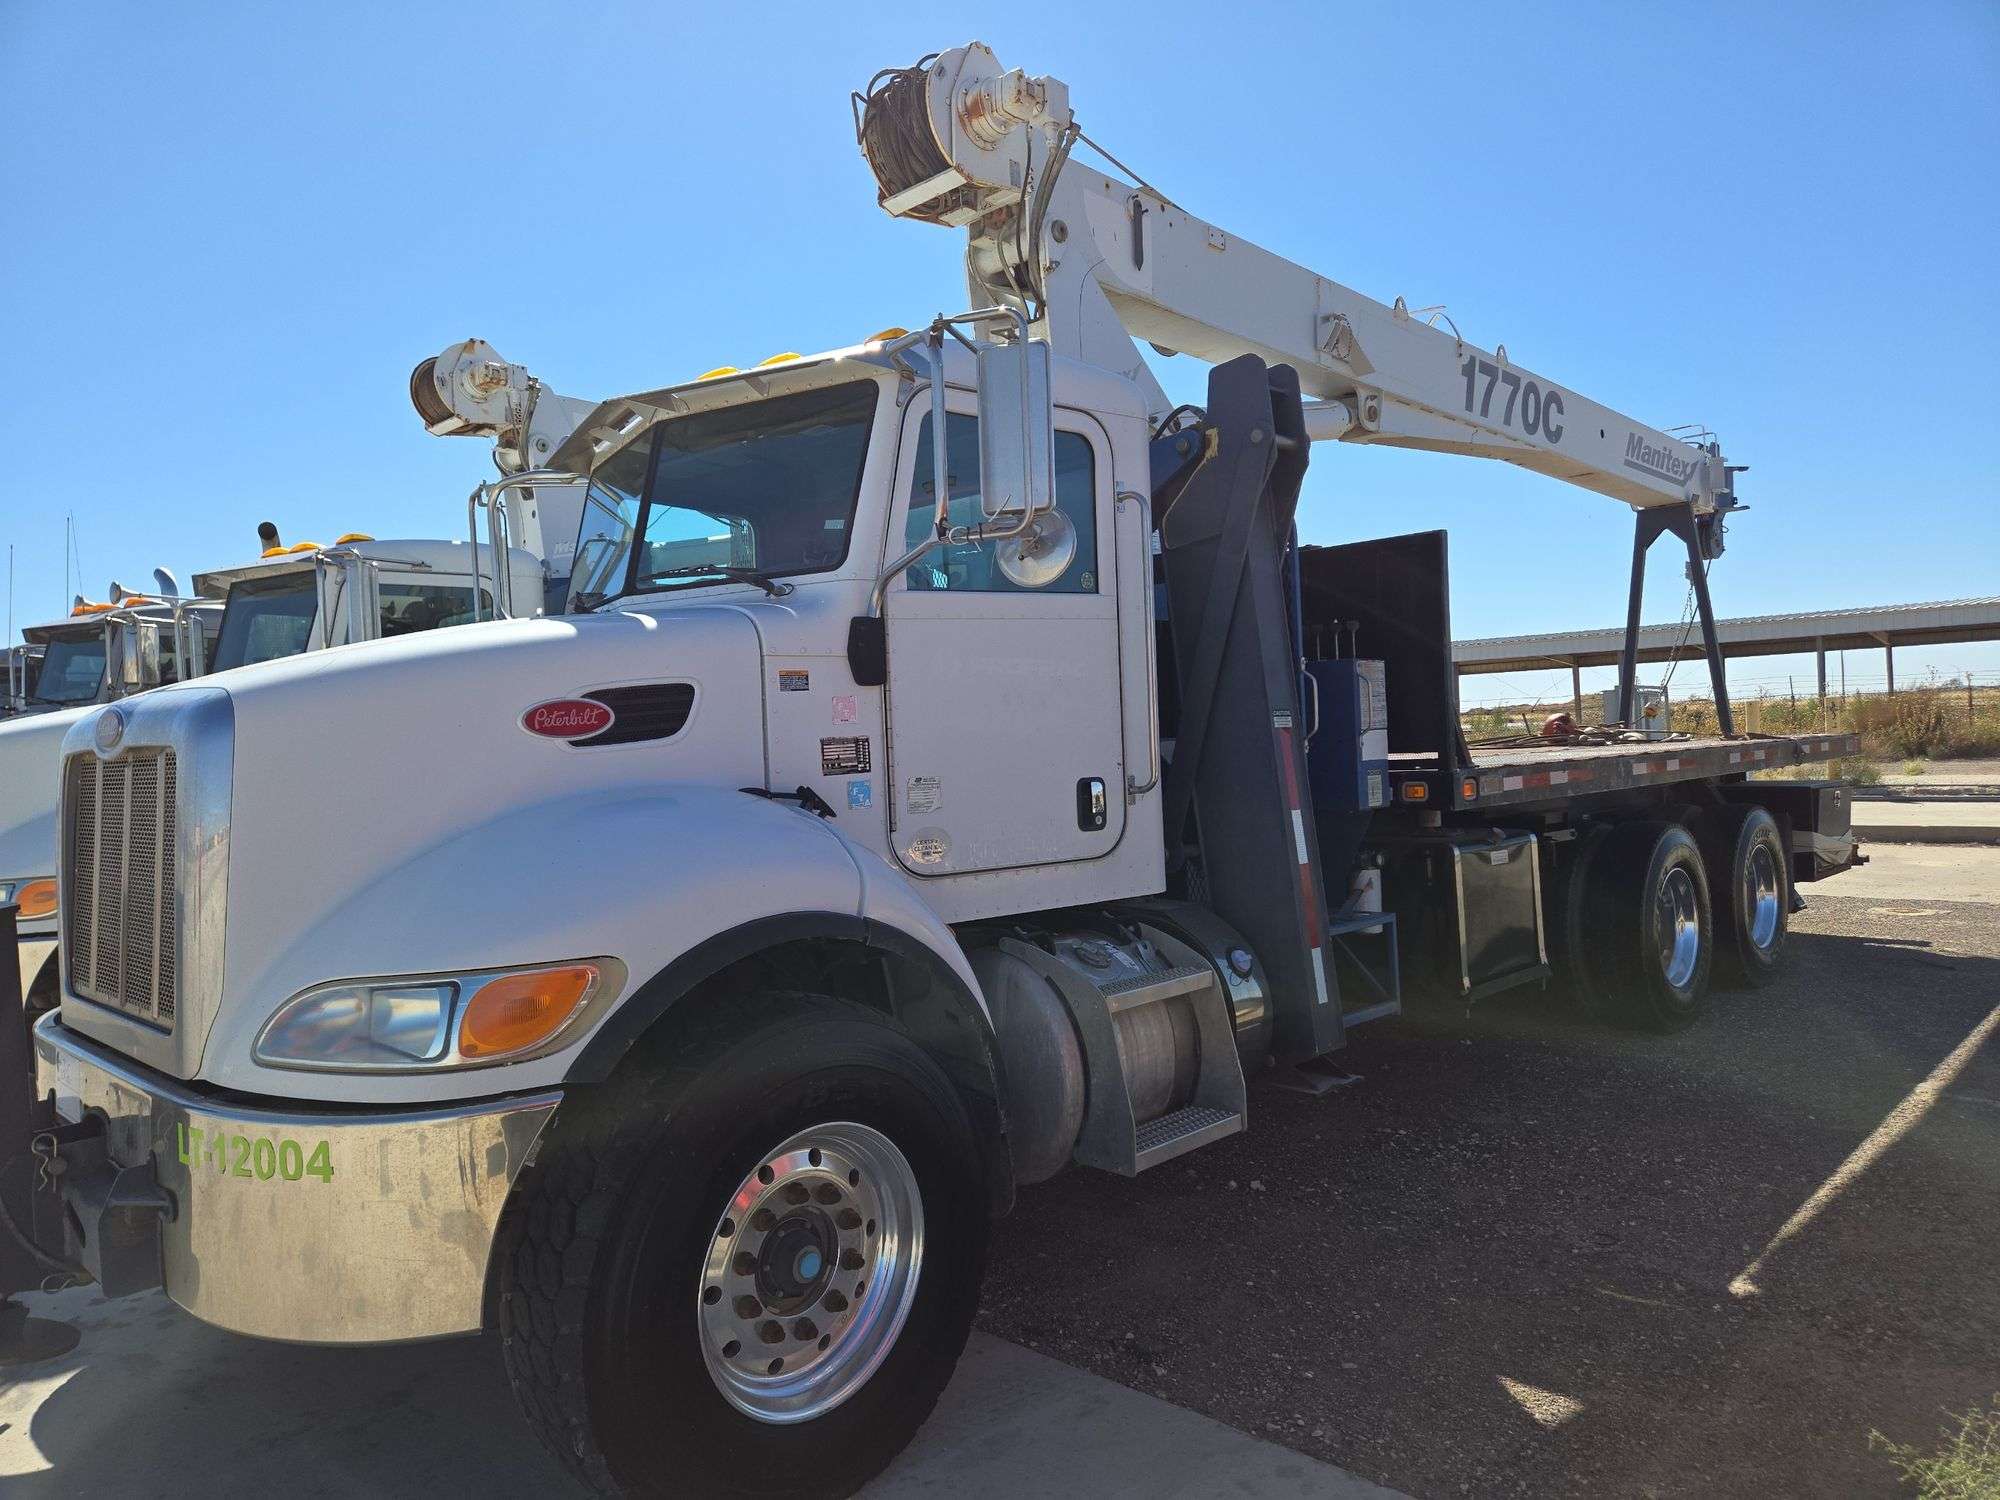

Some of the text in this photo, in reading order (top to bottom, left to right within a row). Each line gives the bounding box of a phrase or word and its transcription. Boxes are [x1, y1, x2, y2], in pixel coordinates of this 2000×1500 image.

[1461, 356, 1564, 444] 1770C
[1625, 432, 1694, 481] Manitex
[535, 708, 604, 730] Peterbilt
[177, 1122, 335, 1184] LT-12004
